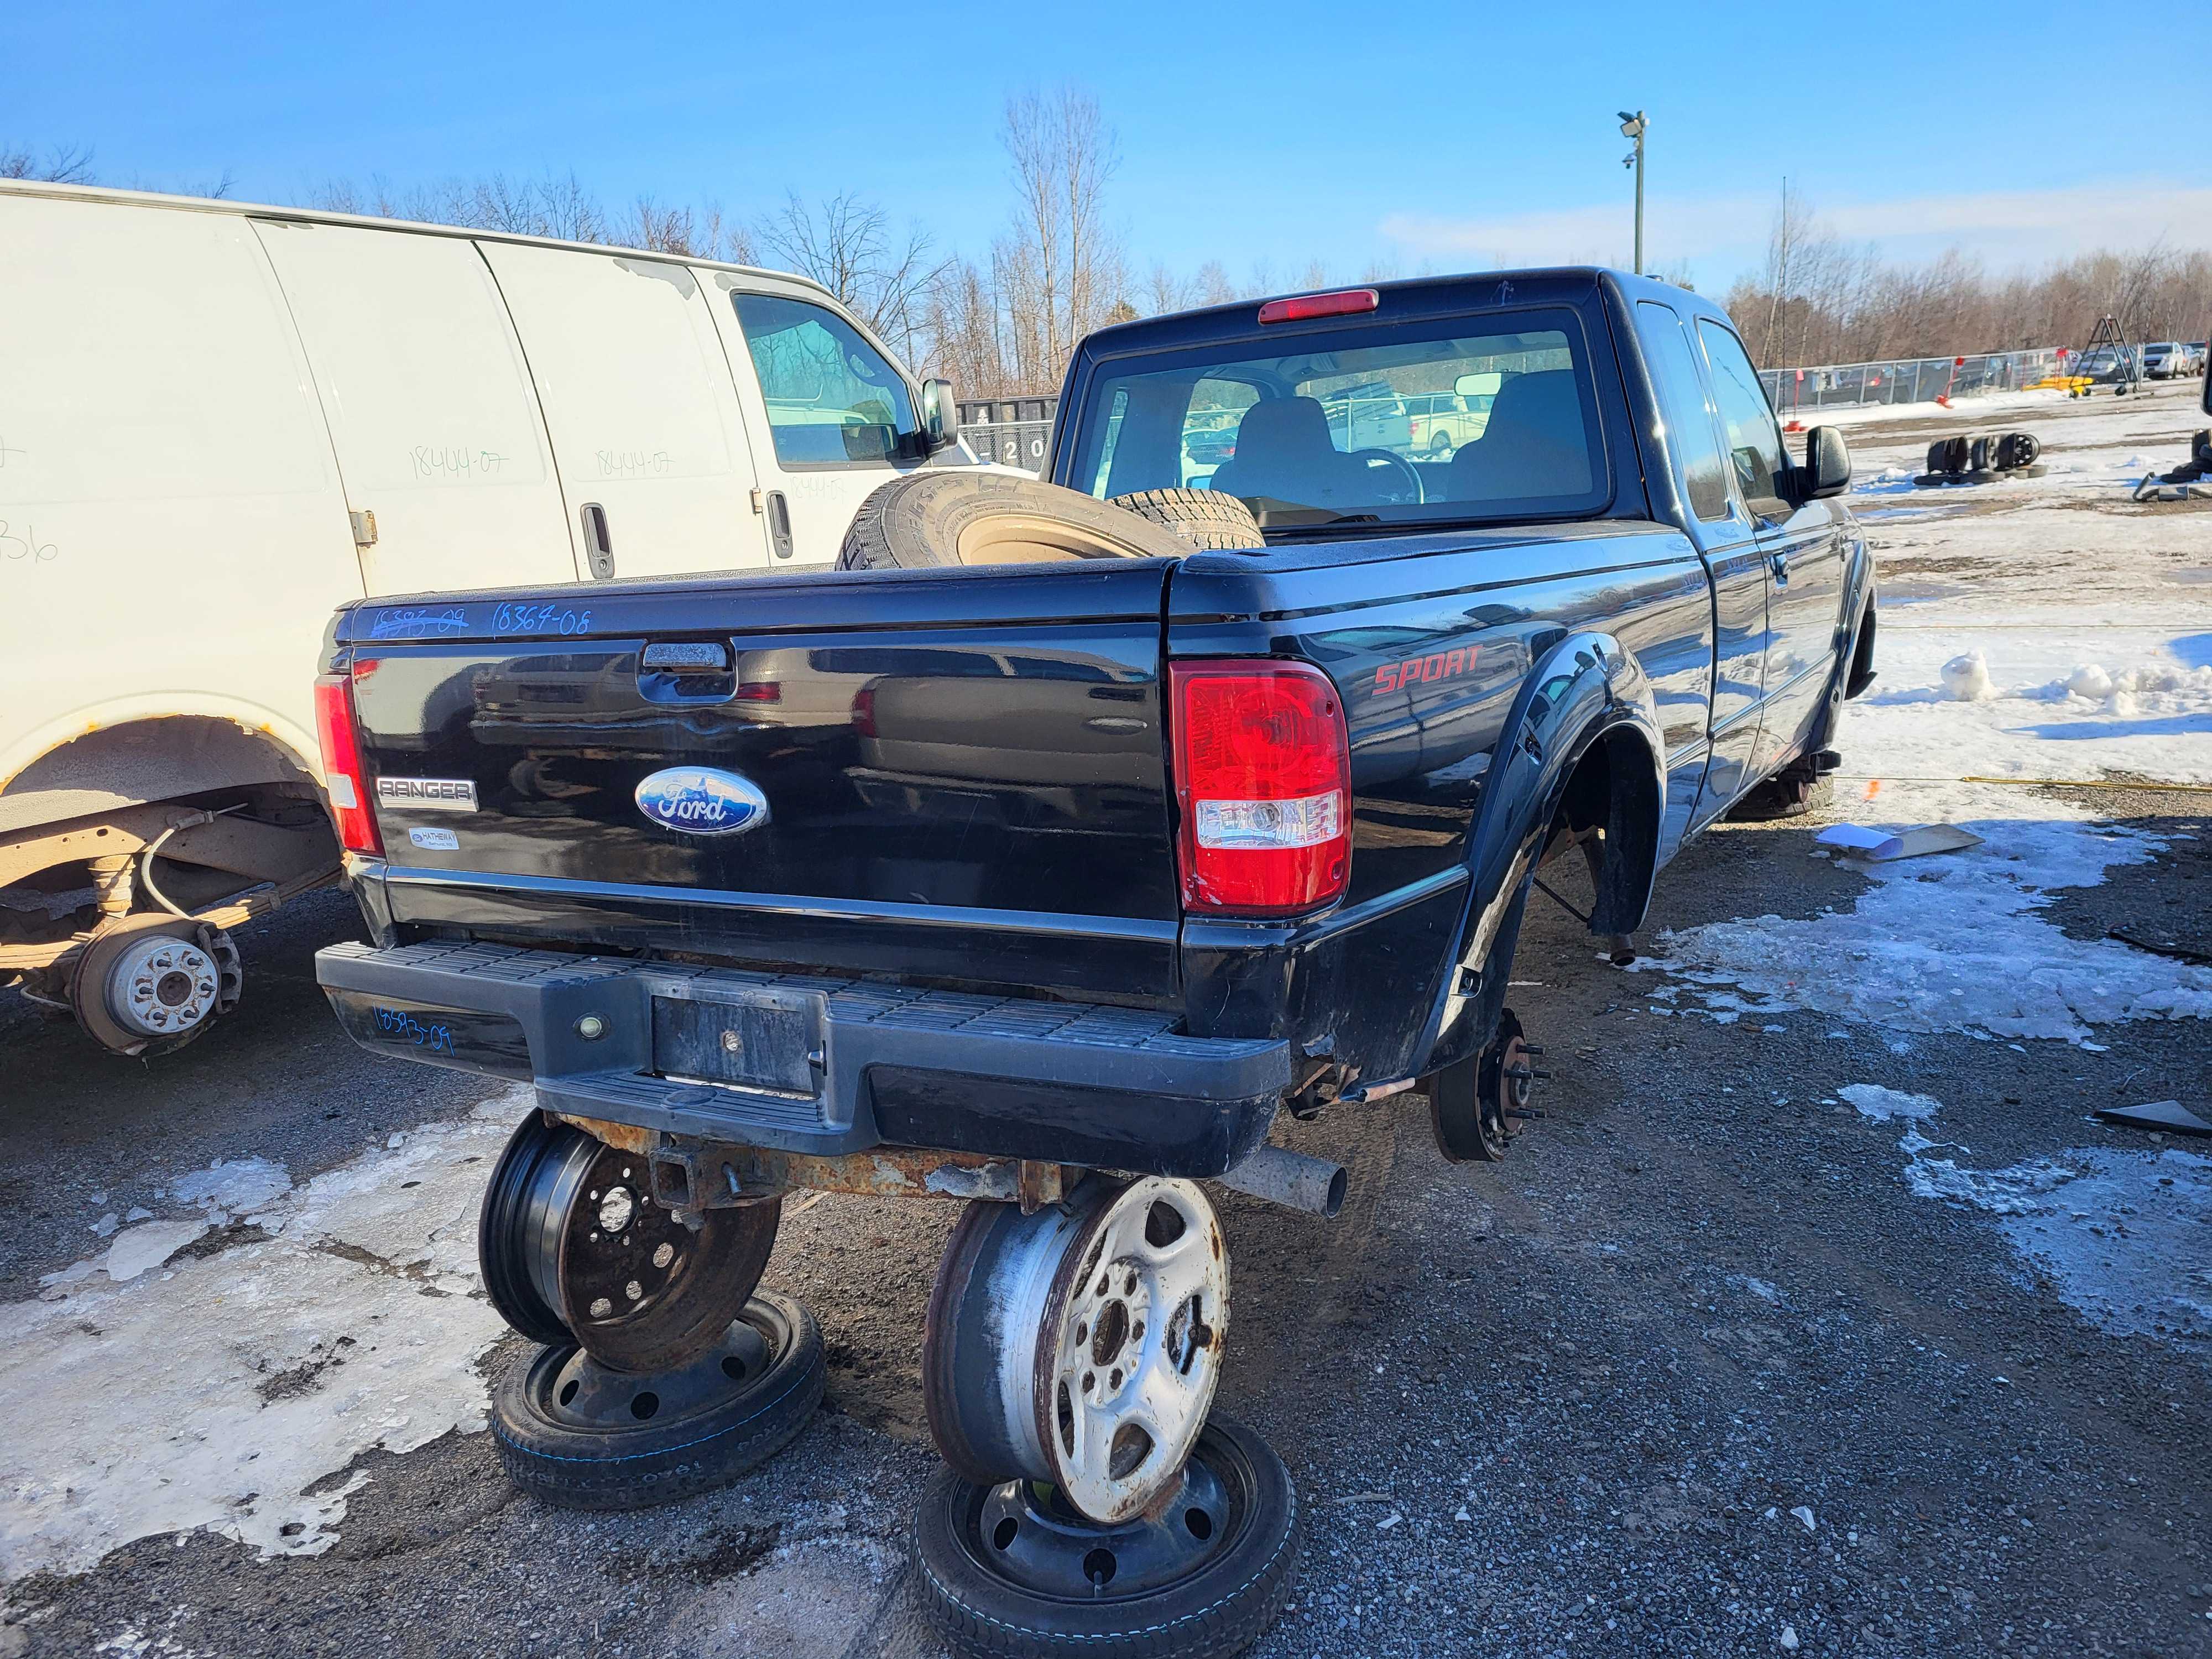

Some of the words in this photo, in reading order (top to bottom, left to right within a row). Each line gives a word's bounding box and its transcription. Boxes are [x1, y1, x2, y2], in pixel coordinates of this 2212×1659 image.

[409, 445, 510, 480] 18444-07
[594, 450, 676, 477] 18444-07
[1371, 644, 1484, 697] SPORT
[379, 780, 473, 800] RANGER
[658, 781, 727, 821] Ford
